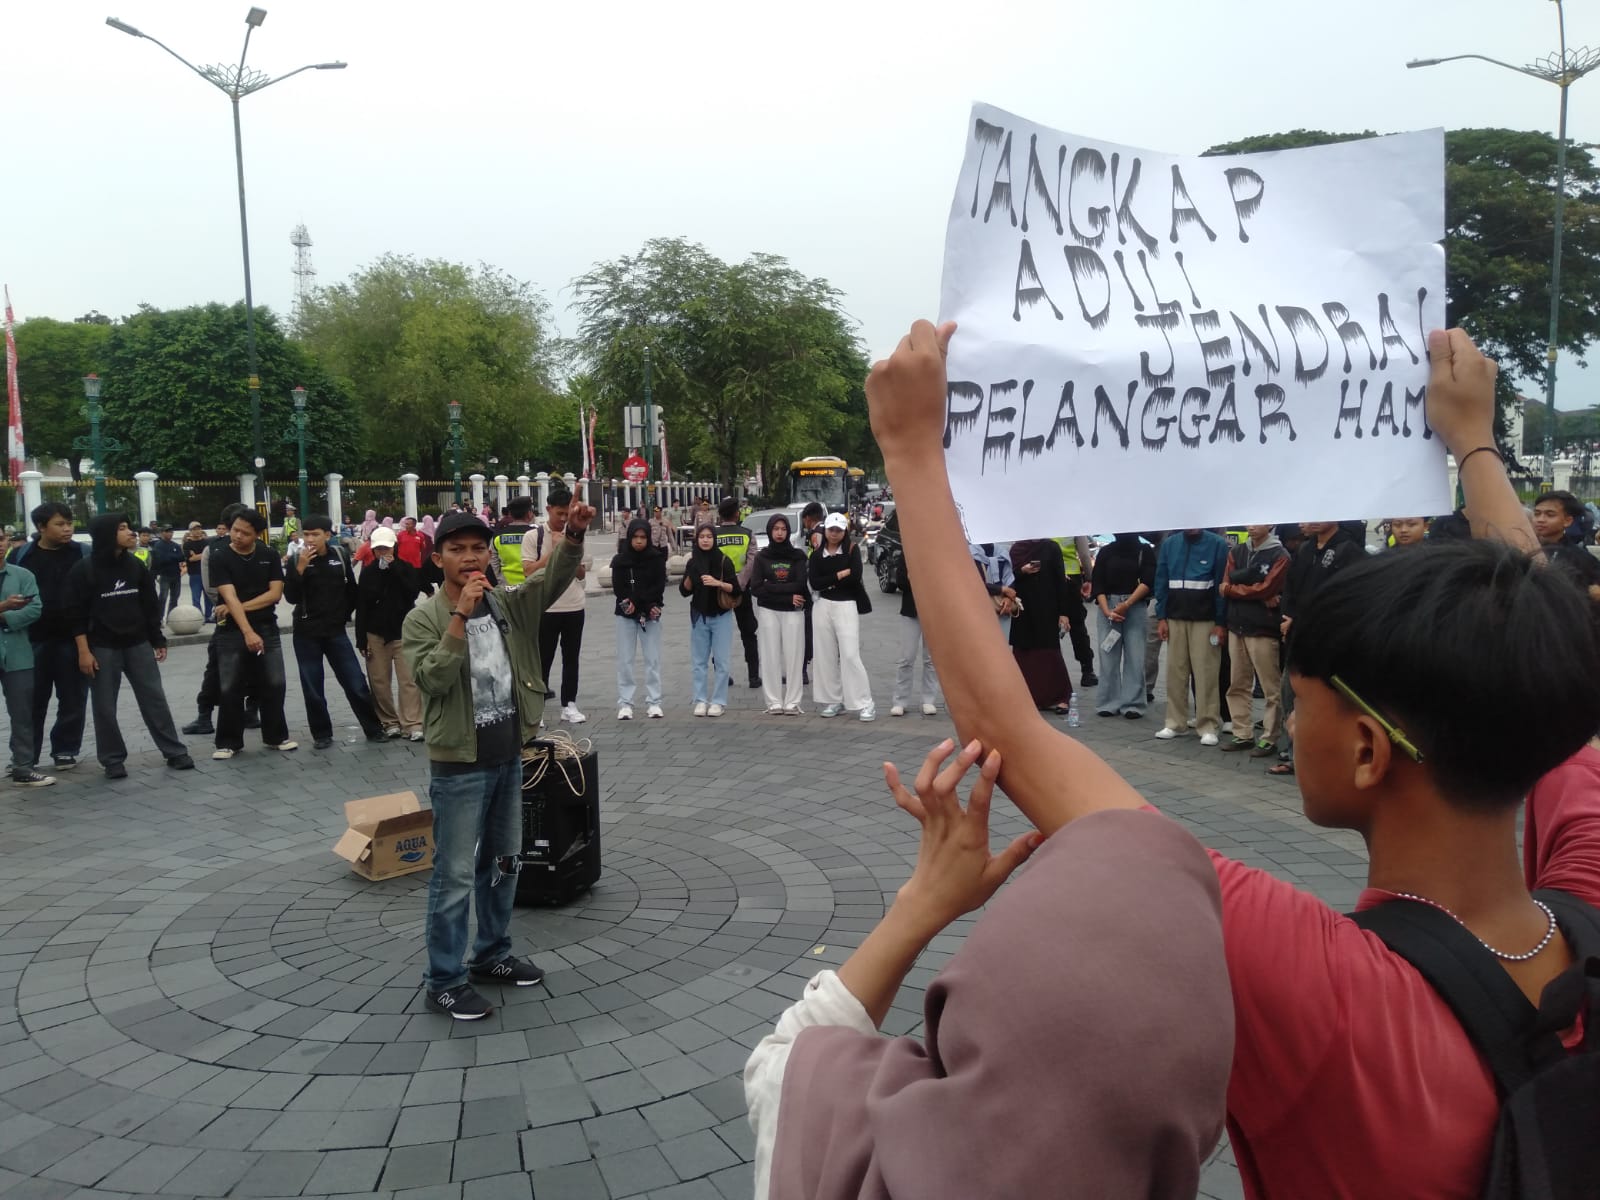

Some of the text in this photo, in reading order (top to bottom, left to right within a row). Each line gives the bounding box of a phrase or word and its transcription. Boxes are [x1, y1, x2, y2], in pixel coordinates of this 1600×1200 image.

[971, 118, 1264, 256] TANGKAP
[943, 378, 1432, 474] PELANGGAR HAM
[501, 535, 523, 544] POLI
[716, 536, 743, 546] POLISI
[395, 835, 427, 853] AQUA
